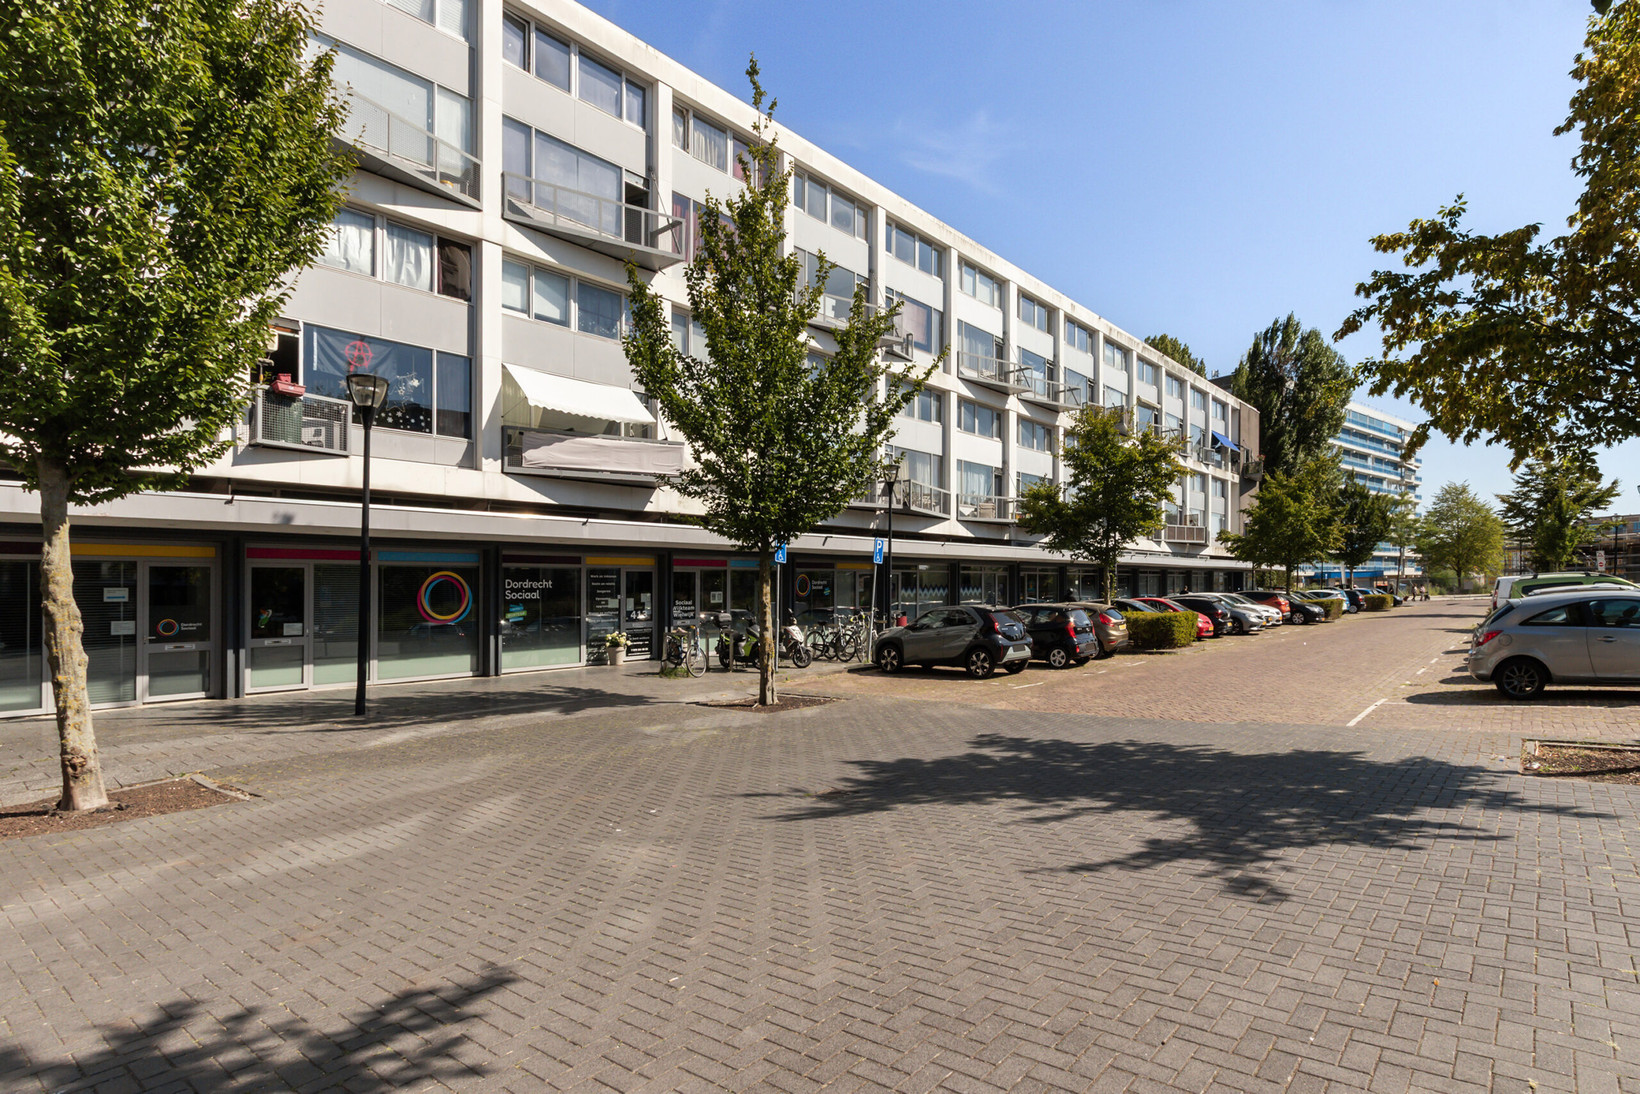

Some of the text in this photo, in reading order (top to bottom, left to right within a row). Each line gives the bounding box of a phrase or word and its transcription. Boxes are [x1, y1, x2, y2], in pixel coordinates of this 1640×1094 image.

[876, 540, 883, 552] P
[505, 579, 553, 589] Dordrecht
[505, 590, 540, 600] Sociaal
[630, 610, 648, 619] 413
